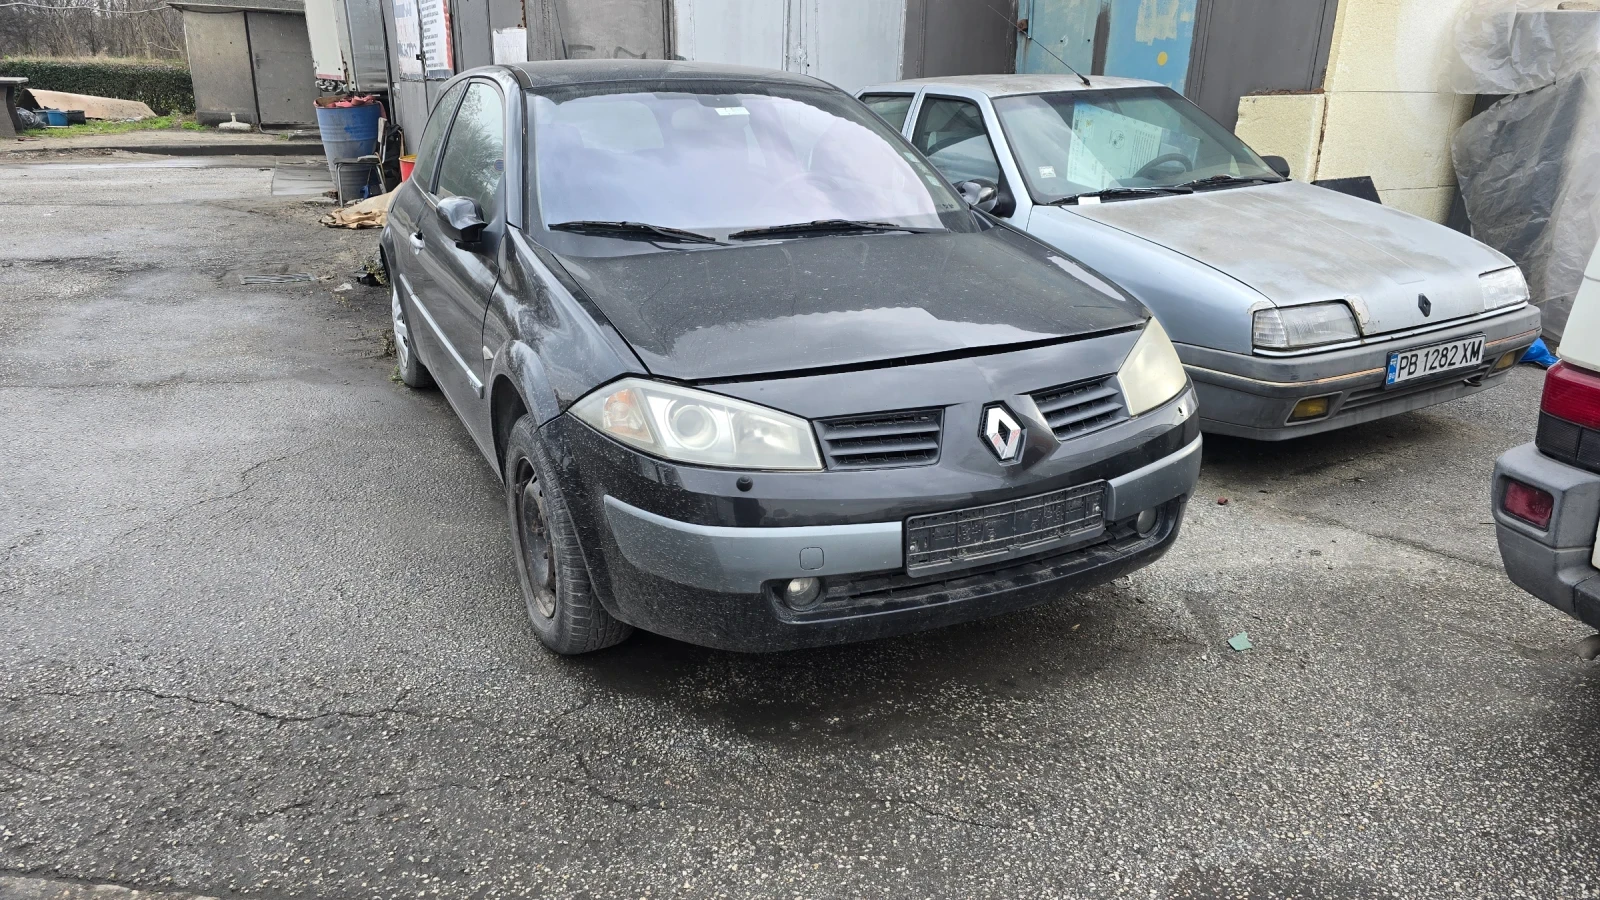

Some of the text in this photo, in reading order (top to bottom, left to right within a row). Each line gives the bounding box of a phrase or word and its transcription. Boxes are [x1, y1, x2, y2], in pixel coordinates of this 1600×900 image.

[1398, 340, 1482, 378] PB 1282 XM
